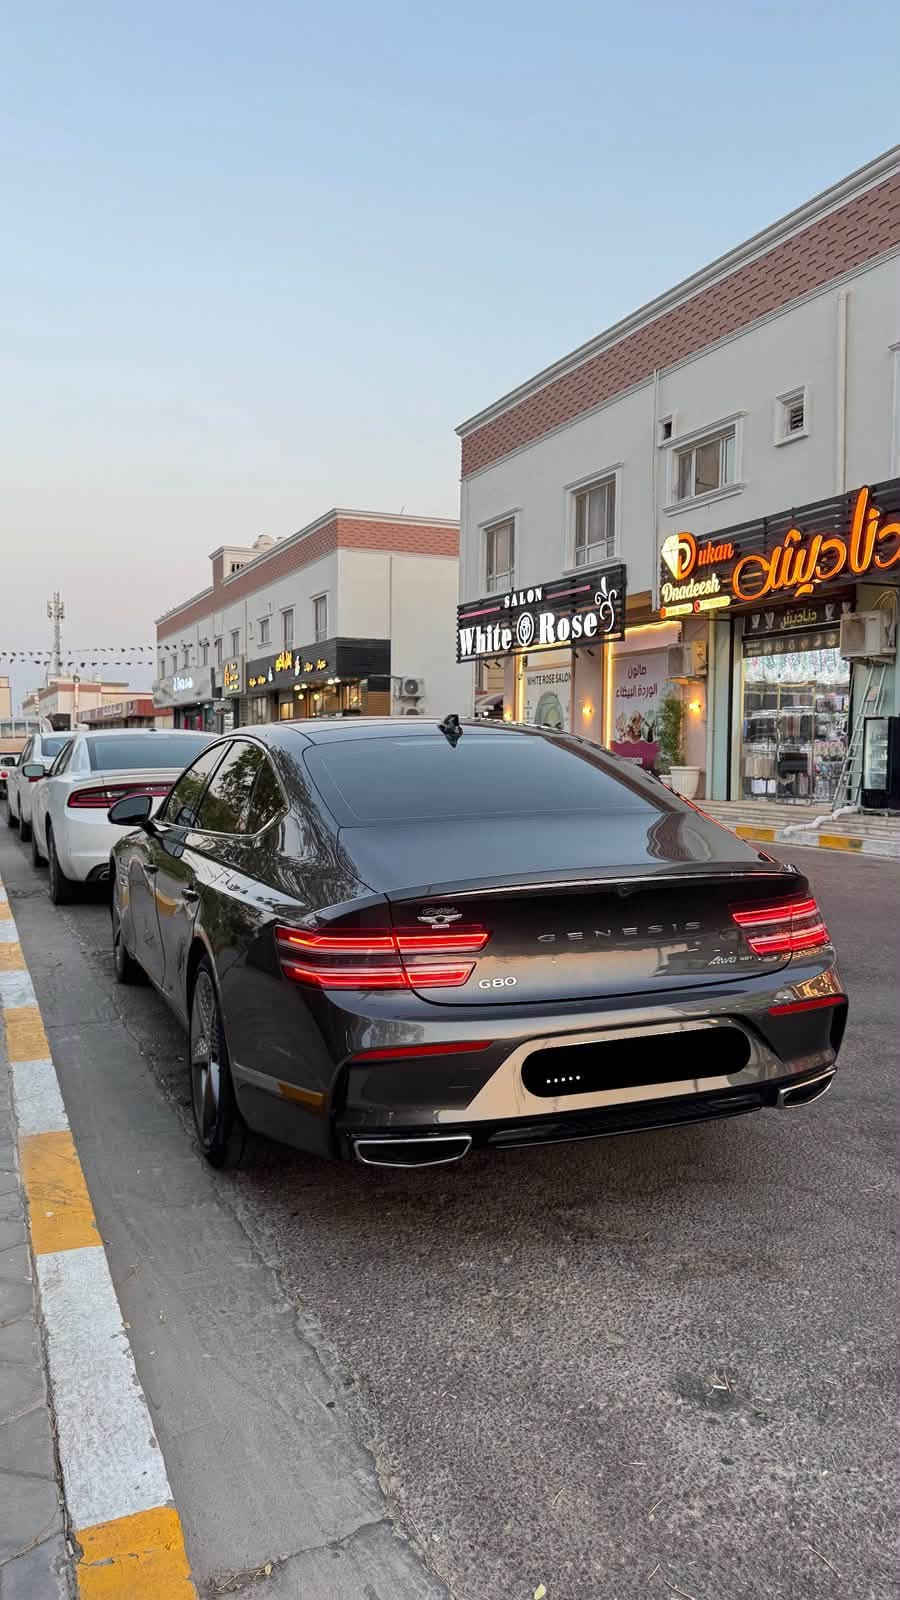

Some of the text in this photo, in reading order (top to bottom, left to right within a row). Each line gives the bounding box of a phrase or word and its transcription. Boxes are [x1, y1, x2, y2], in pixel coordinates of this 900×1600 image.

[677, 532, 734, 580] Dukan
[504, 587, 543, 609] SALON
[661, 573, 720, 602] Dnadeesh
[458, 612, 598, 657] White Rose
[536, 921, 702, 943] GENESIS
[478, 976, 517, 990] G80
